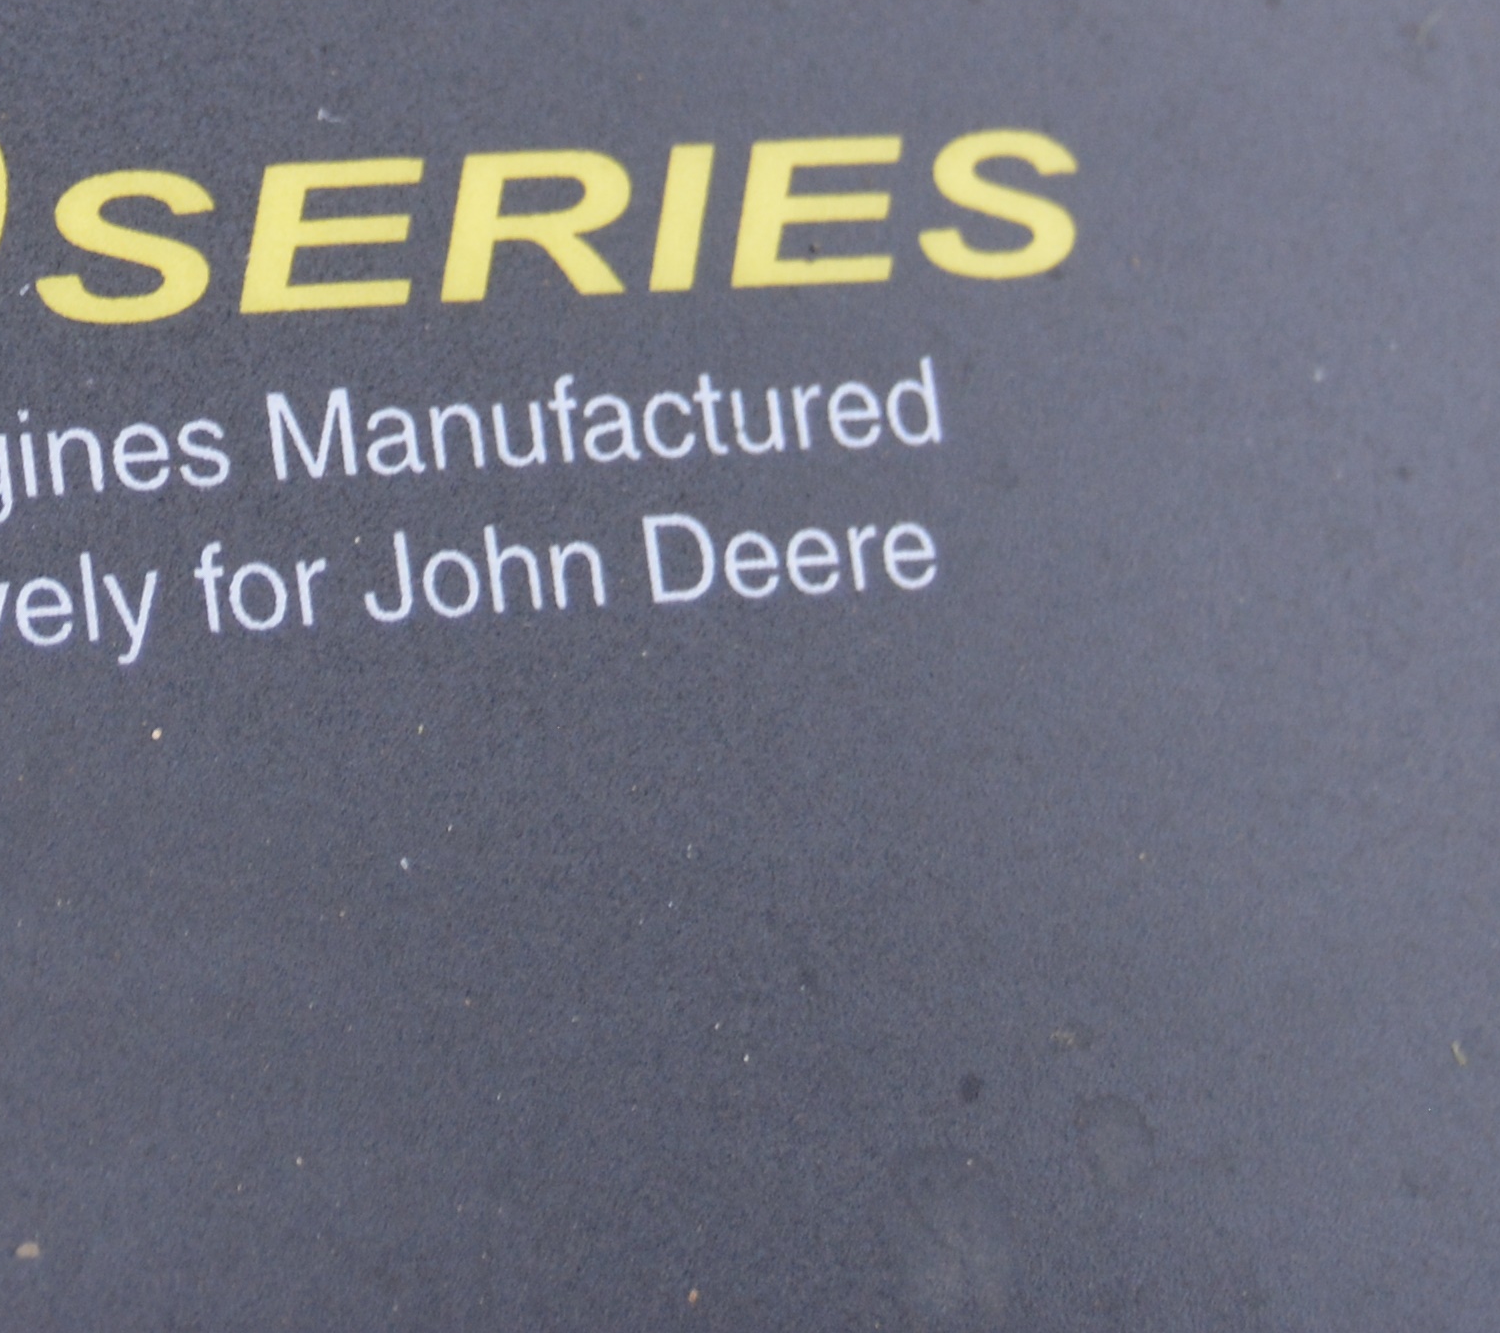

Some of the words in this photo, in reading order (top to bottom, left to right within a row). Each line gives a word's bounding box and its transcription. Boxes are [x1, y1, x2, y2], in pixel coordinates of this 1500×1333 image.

[36, 129, 1077, 324] SERIES
[266, 356, 944, 481] Manufactured
[194, 541, 327, 633] for
[364, 524, 607, 623] John
[642, 513, 938, 604] Deere
